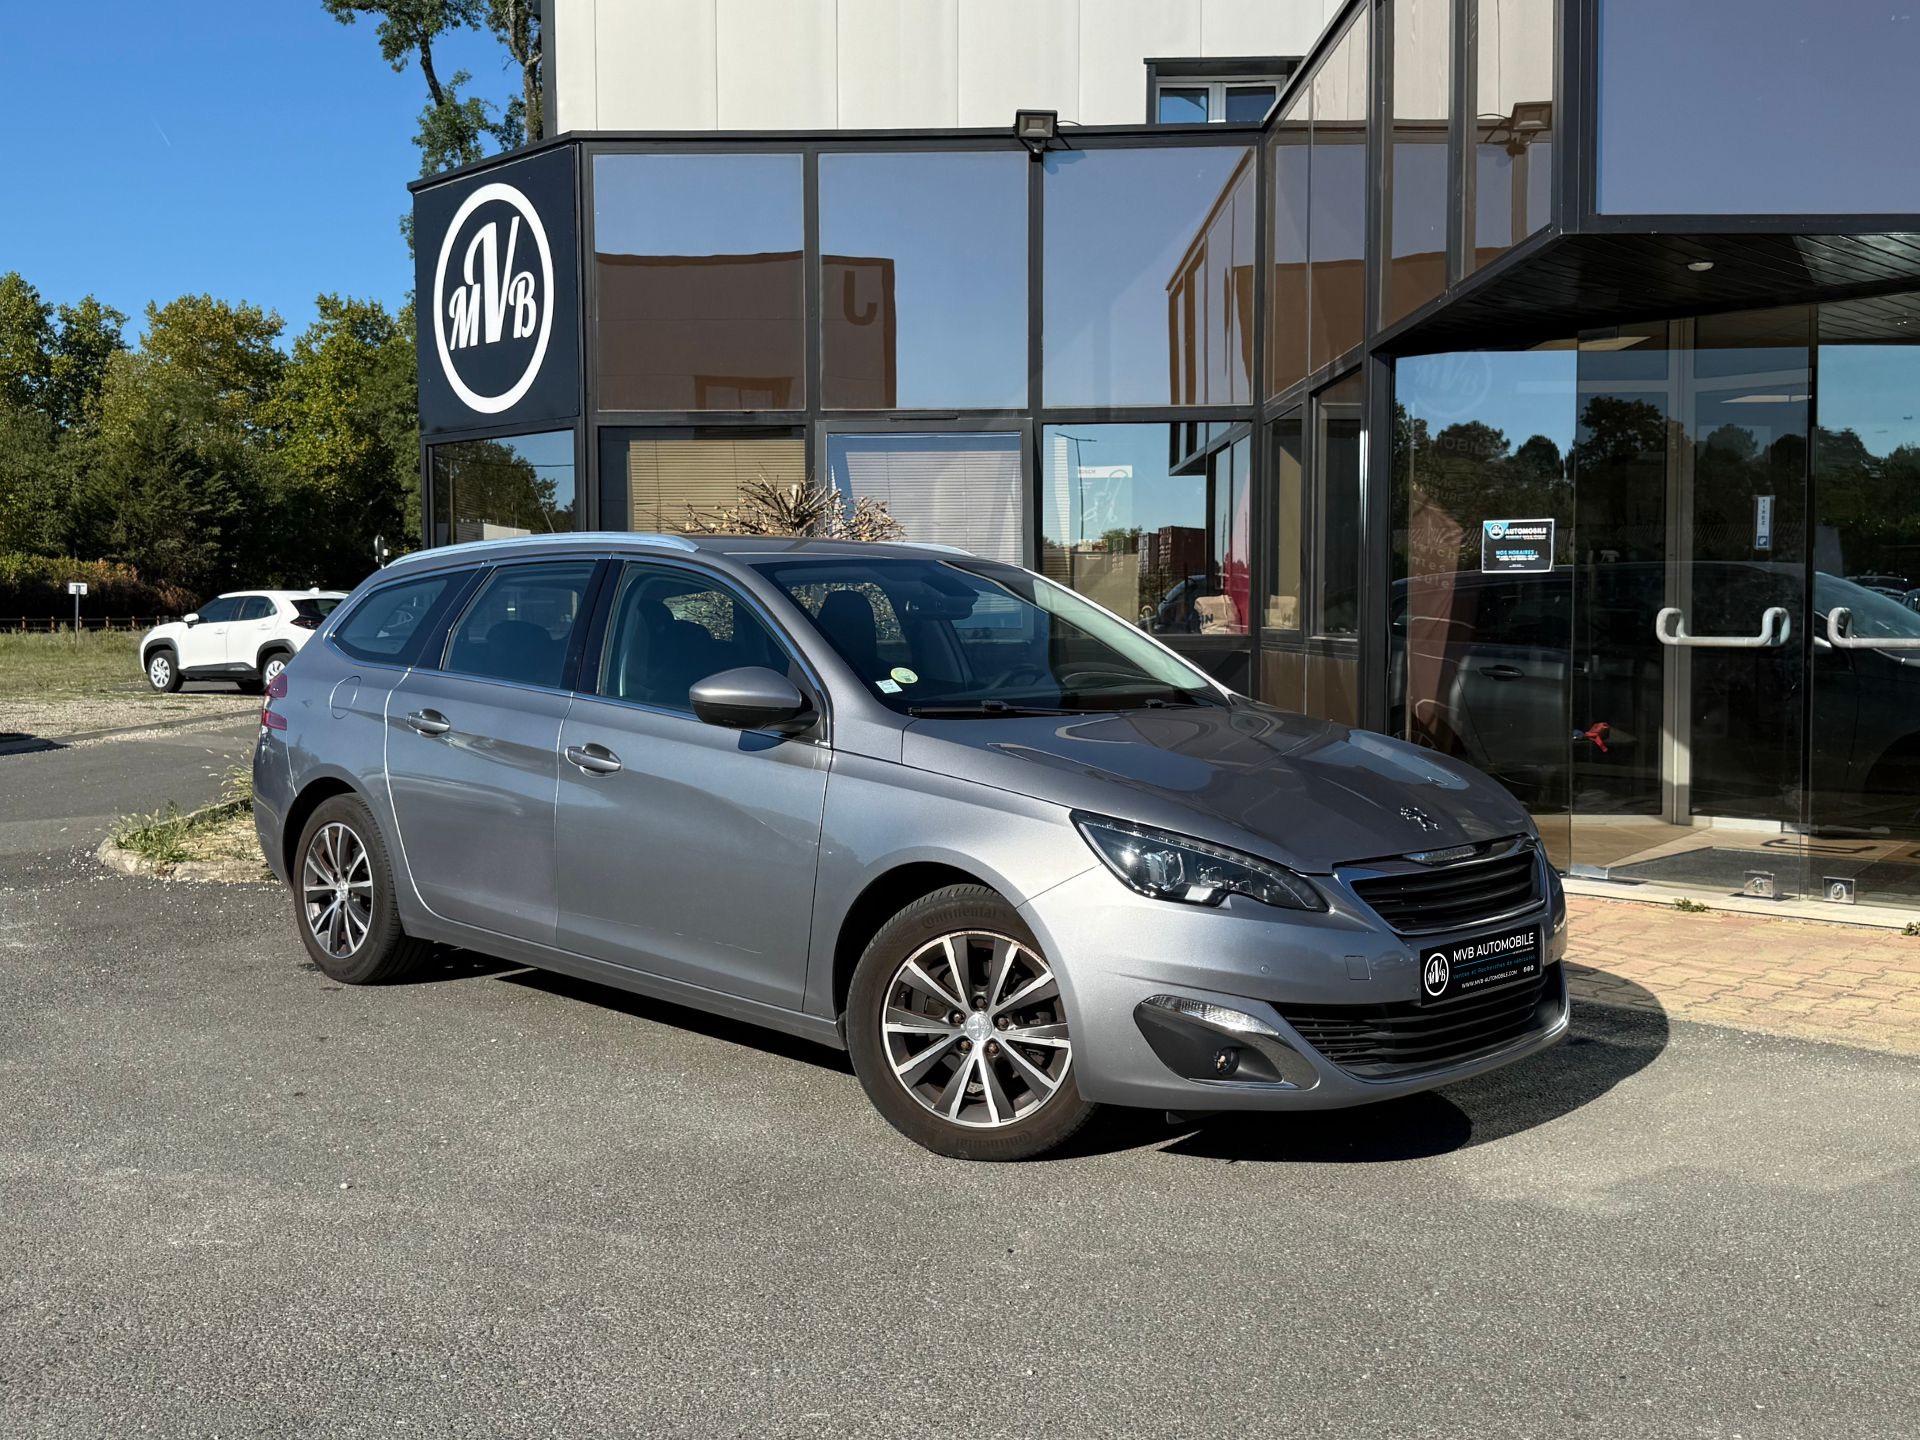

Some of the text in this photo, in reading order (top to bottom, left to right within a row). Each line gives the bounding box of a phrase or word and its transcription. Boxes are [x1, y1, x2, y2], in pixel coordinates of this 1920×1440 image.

[449, 216, 537, 350] MVB
[1505, 527, 1547, 535] AUTOMOBILE
[1453, 946, 1475, 963] MVB
[1476, 932, 1535, 957] AUTOMOBILE
[1427, 959, 1446, 985] MVB
